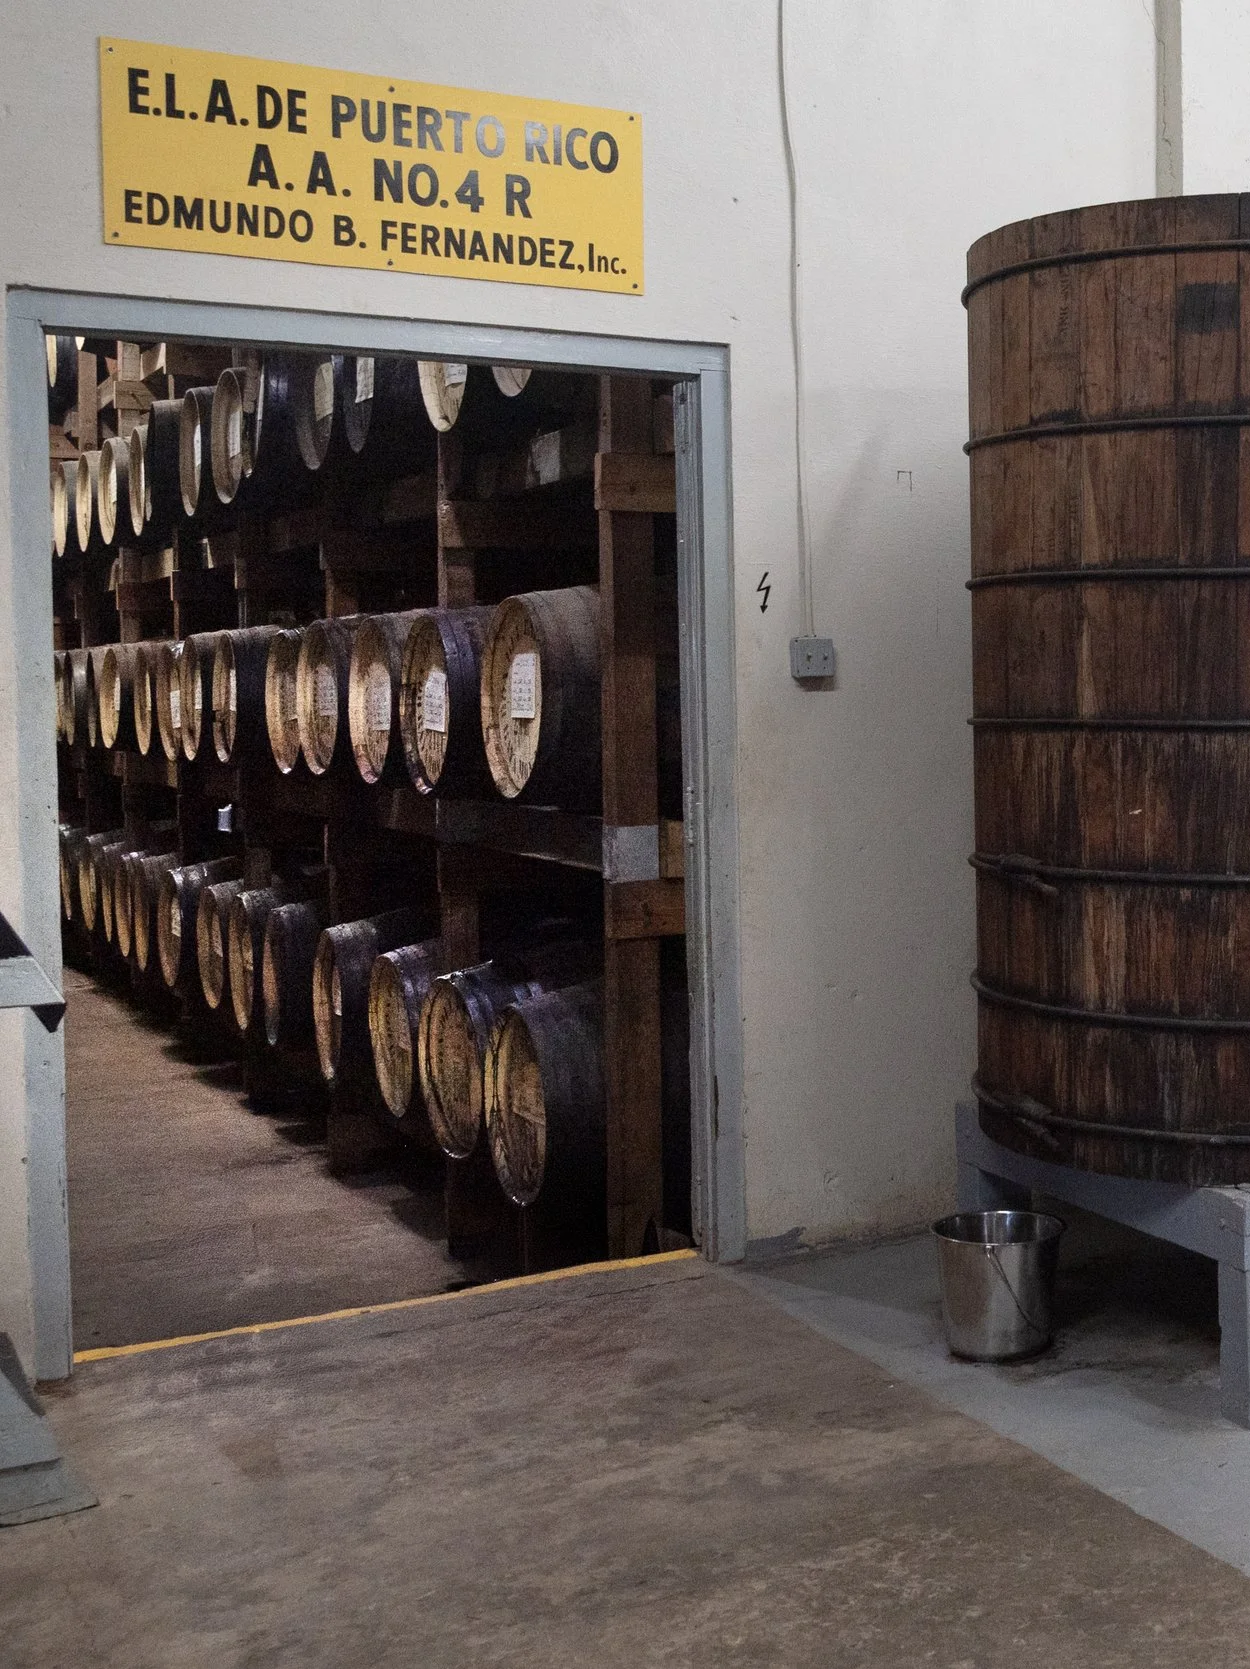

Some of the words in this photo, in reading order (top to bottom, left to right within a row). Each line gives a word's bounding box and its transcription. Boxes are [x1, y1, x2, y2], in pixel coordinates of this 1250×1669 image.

[331, 95, 506, 159] PUERTO
[524, 120, 620, 174] RICO
[123, 188, 314, 243] EDMUNDO
[333, 214, 367, 249] B.
[247, 143, 295, 190] A.
[306, 150, 351, 198] A.
[505, 173, 532, 219] R
